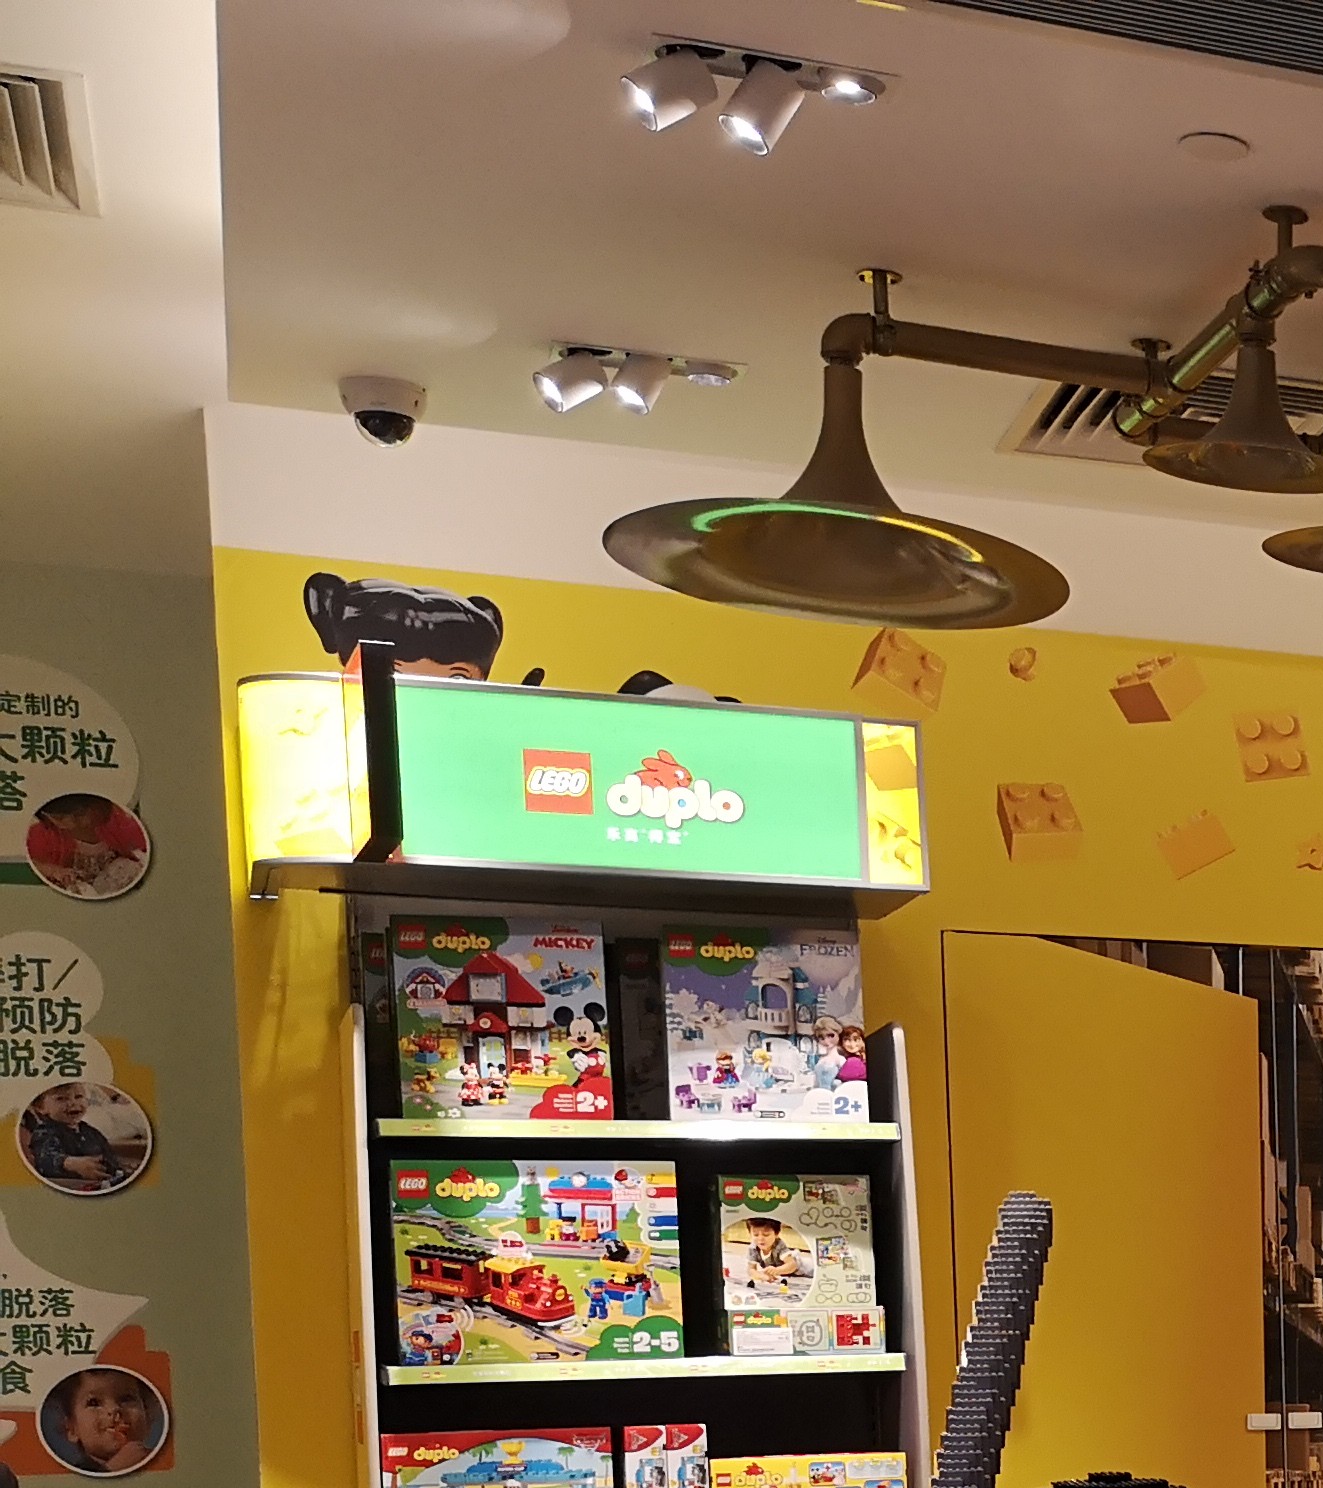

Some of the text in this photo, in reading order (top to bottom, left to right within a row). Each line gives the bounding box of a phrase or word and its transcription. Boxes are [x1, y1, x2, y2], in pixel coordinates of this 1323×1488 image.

[527, 765, 745, 828] LEGO duplo
[400, 930, 491, 953] LEGO duplo
[533, 936, 597, 951] MICKEY
[669, 939, 755, 962] LEGO duplo
[800, 943, 856, 958] FROZEN
[0, 954, 79, 992] 打/
[0, 996, 82, 1034] 预防
[0, 1039, 87, 1077] 脱落
[576, 1091, 608, 1113] 2+
[834, 1096, 862, 1115] 2+
[398, 1177, 500, 1202] LEGO duplo
[748, 1184, 789, 1201] duplo
[0, 1288, 75, 1318] 脱落
[0, 1322, 97, 1356] 颗粒
[632, 1331, 680, 1353] 2-5
[387, 1446, 460, 1463] LEGO duplo
[734, 1471, 784, 1488] duplo
